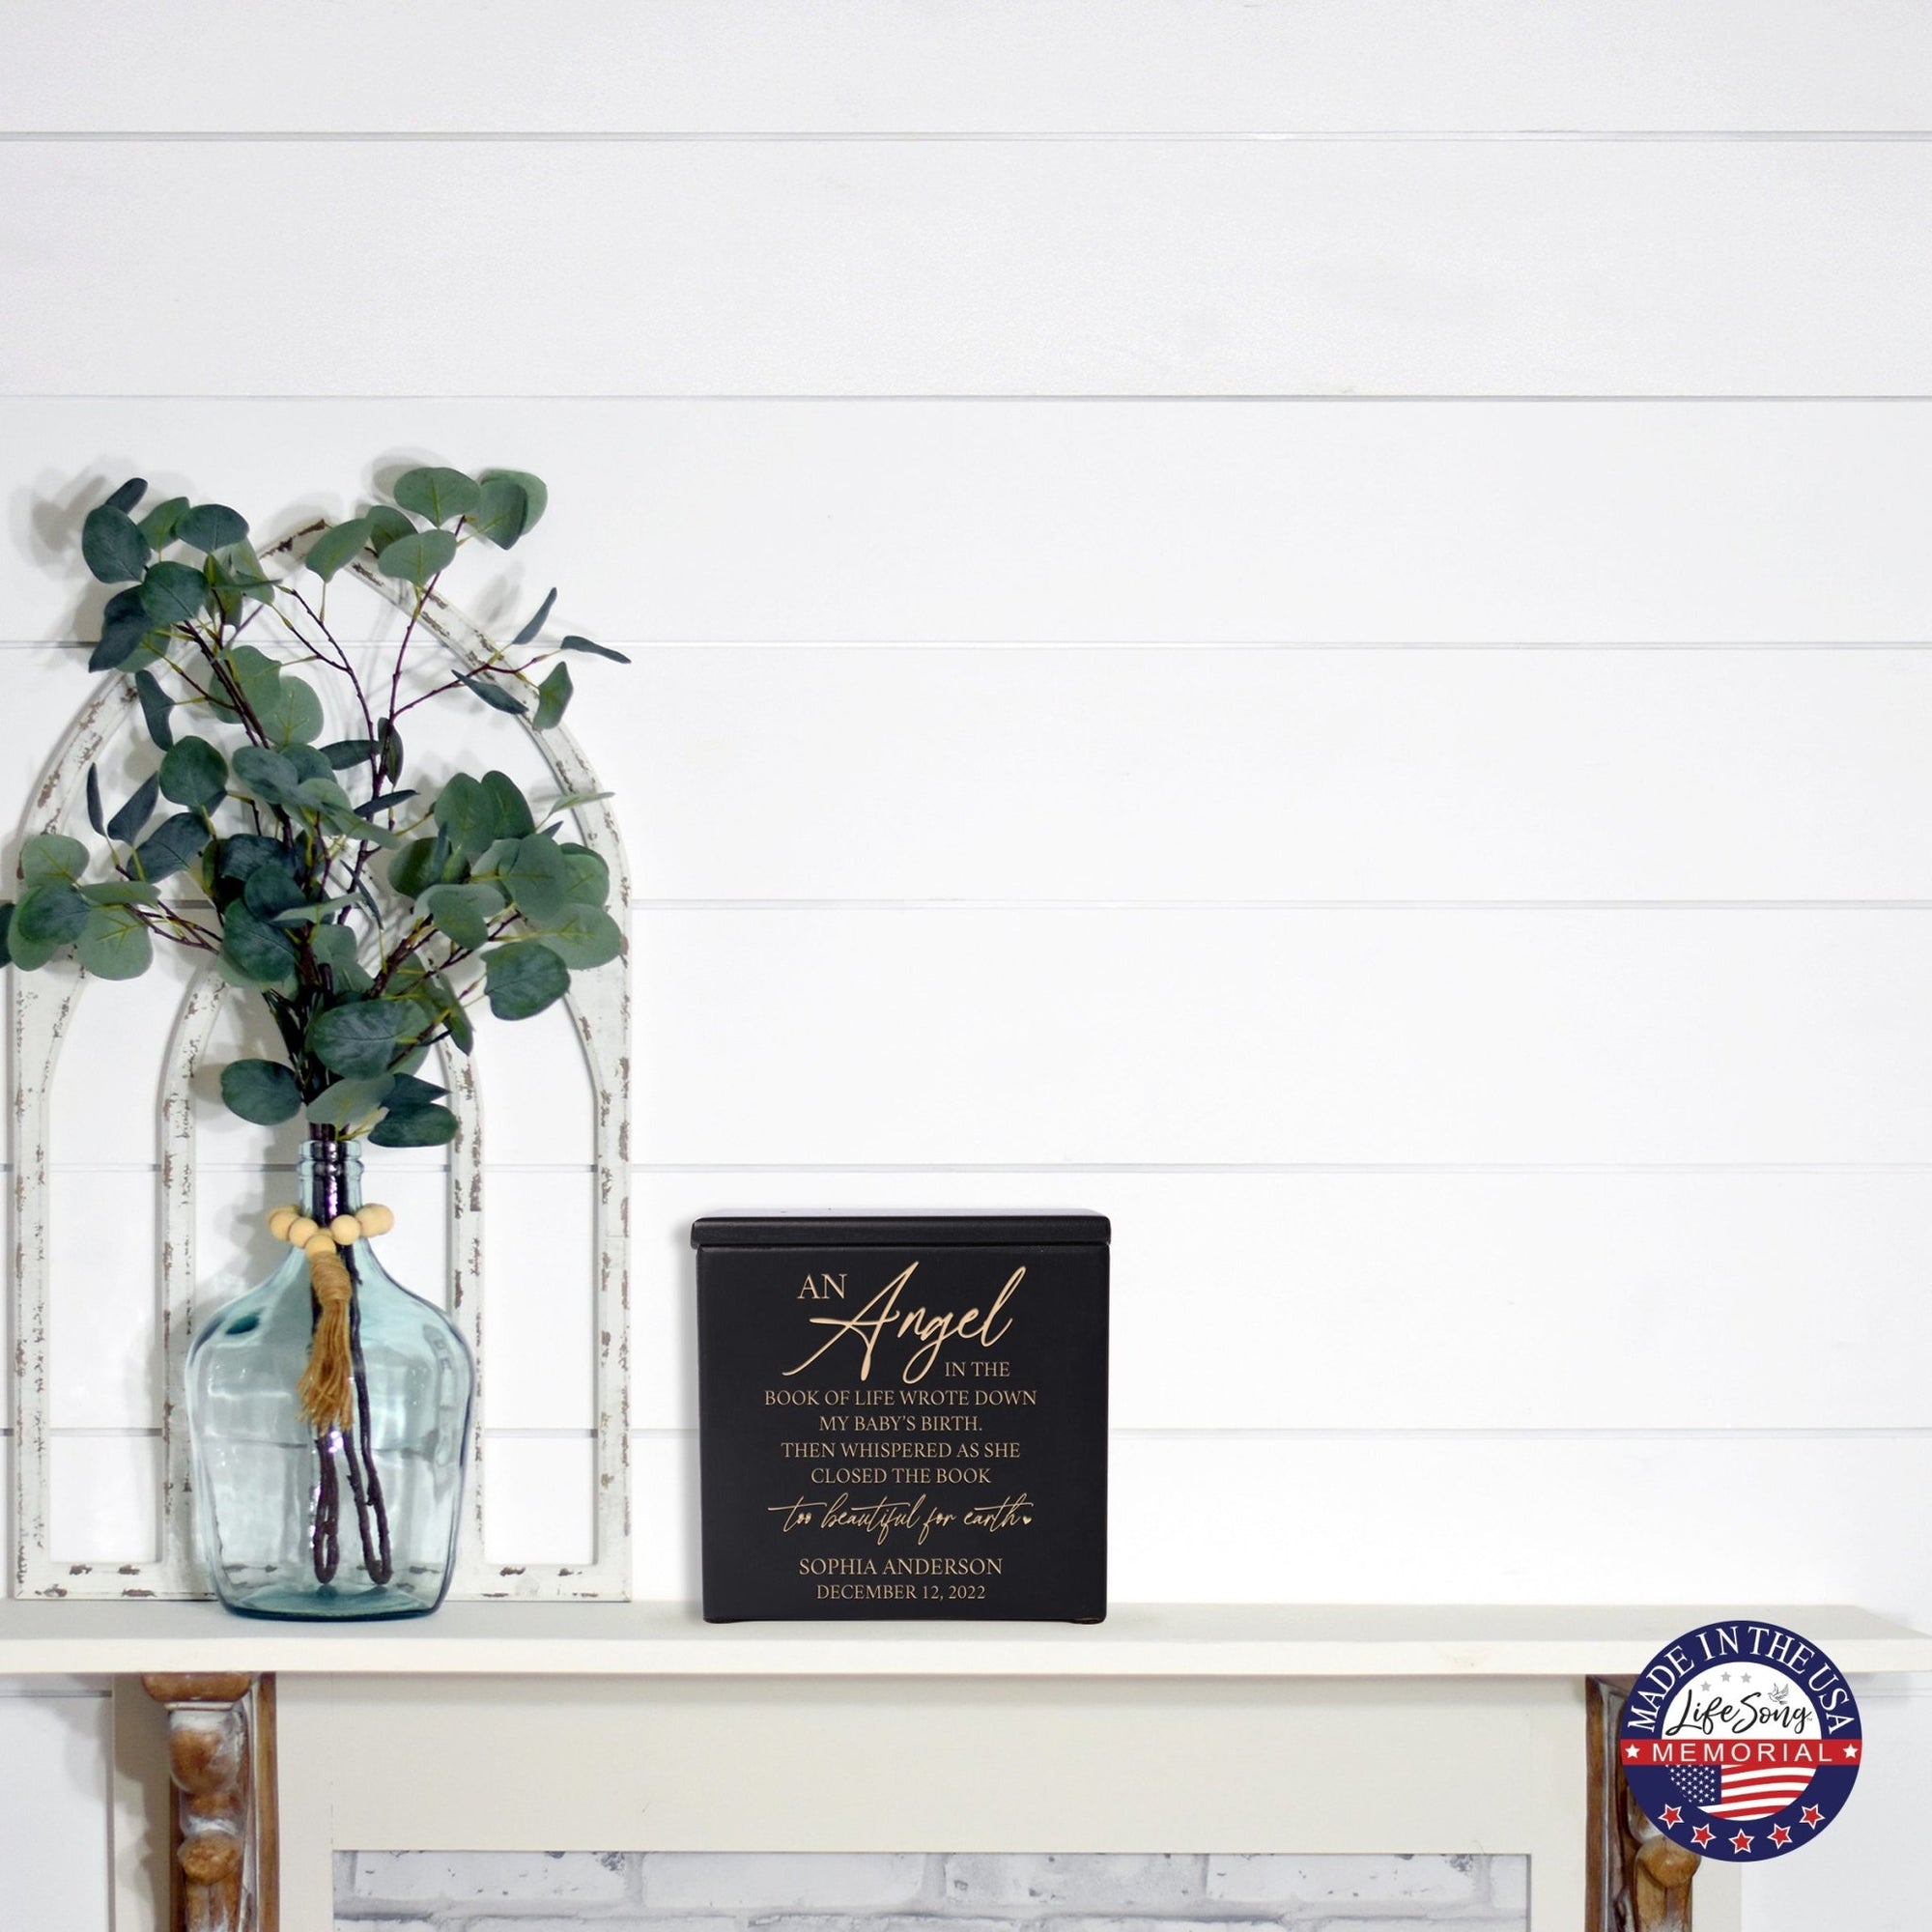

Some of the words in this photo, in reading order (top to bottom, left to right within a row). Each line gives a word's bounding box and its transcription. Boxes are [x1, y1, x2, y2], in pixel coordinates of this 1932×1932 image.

[797, 1273, 847, 1299] AN
[781, 1261, 1027, 1384] Angel
[945, 1361, 966, 1378] IN
[971, 1361, 1010, 1378] THE
[764, 1389, 819, 1406] BOOK
[824, 1389, 850, 1406] OF
[854, 1389, 895, 1406] LIFE
[898, 1389, 969, 1406] WROTE
[975, 1389, 1037, 1406] DOWN
[819, 1415, 849, 1432] MY
[921, 1415, 982, 1432] BIRTH.
[781, 1442, 836, 1459] THEN
[839, 1442, 952, 1459] WHISPERED
[956, 1442, 980, 1459] AS
[983, 1442, 1020, 1459] SHE
[810, 1467, 887, 1484] CLOSED
[891, 1467, 931, 1484] THE
[936, 1467, 991, 1484] BOOK
[768, 1496, 827, 1532] too
[821, 1492, 926, 1546] beautiful
[918, 1507, 956, 1546] for
[963, 1492, 1034, 1532] earth
[799, 1558, 877, 1576] SOPHIA
[882, 1558, 1003, 1576] ANDERSON
[816, 1584, 918, 1600] DECEMBER
[923, 1585, 944, 1601] 12,
[948, 1585, 985, 1600] 2022
